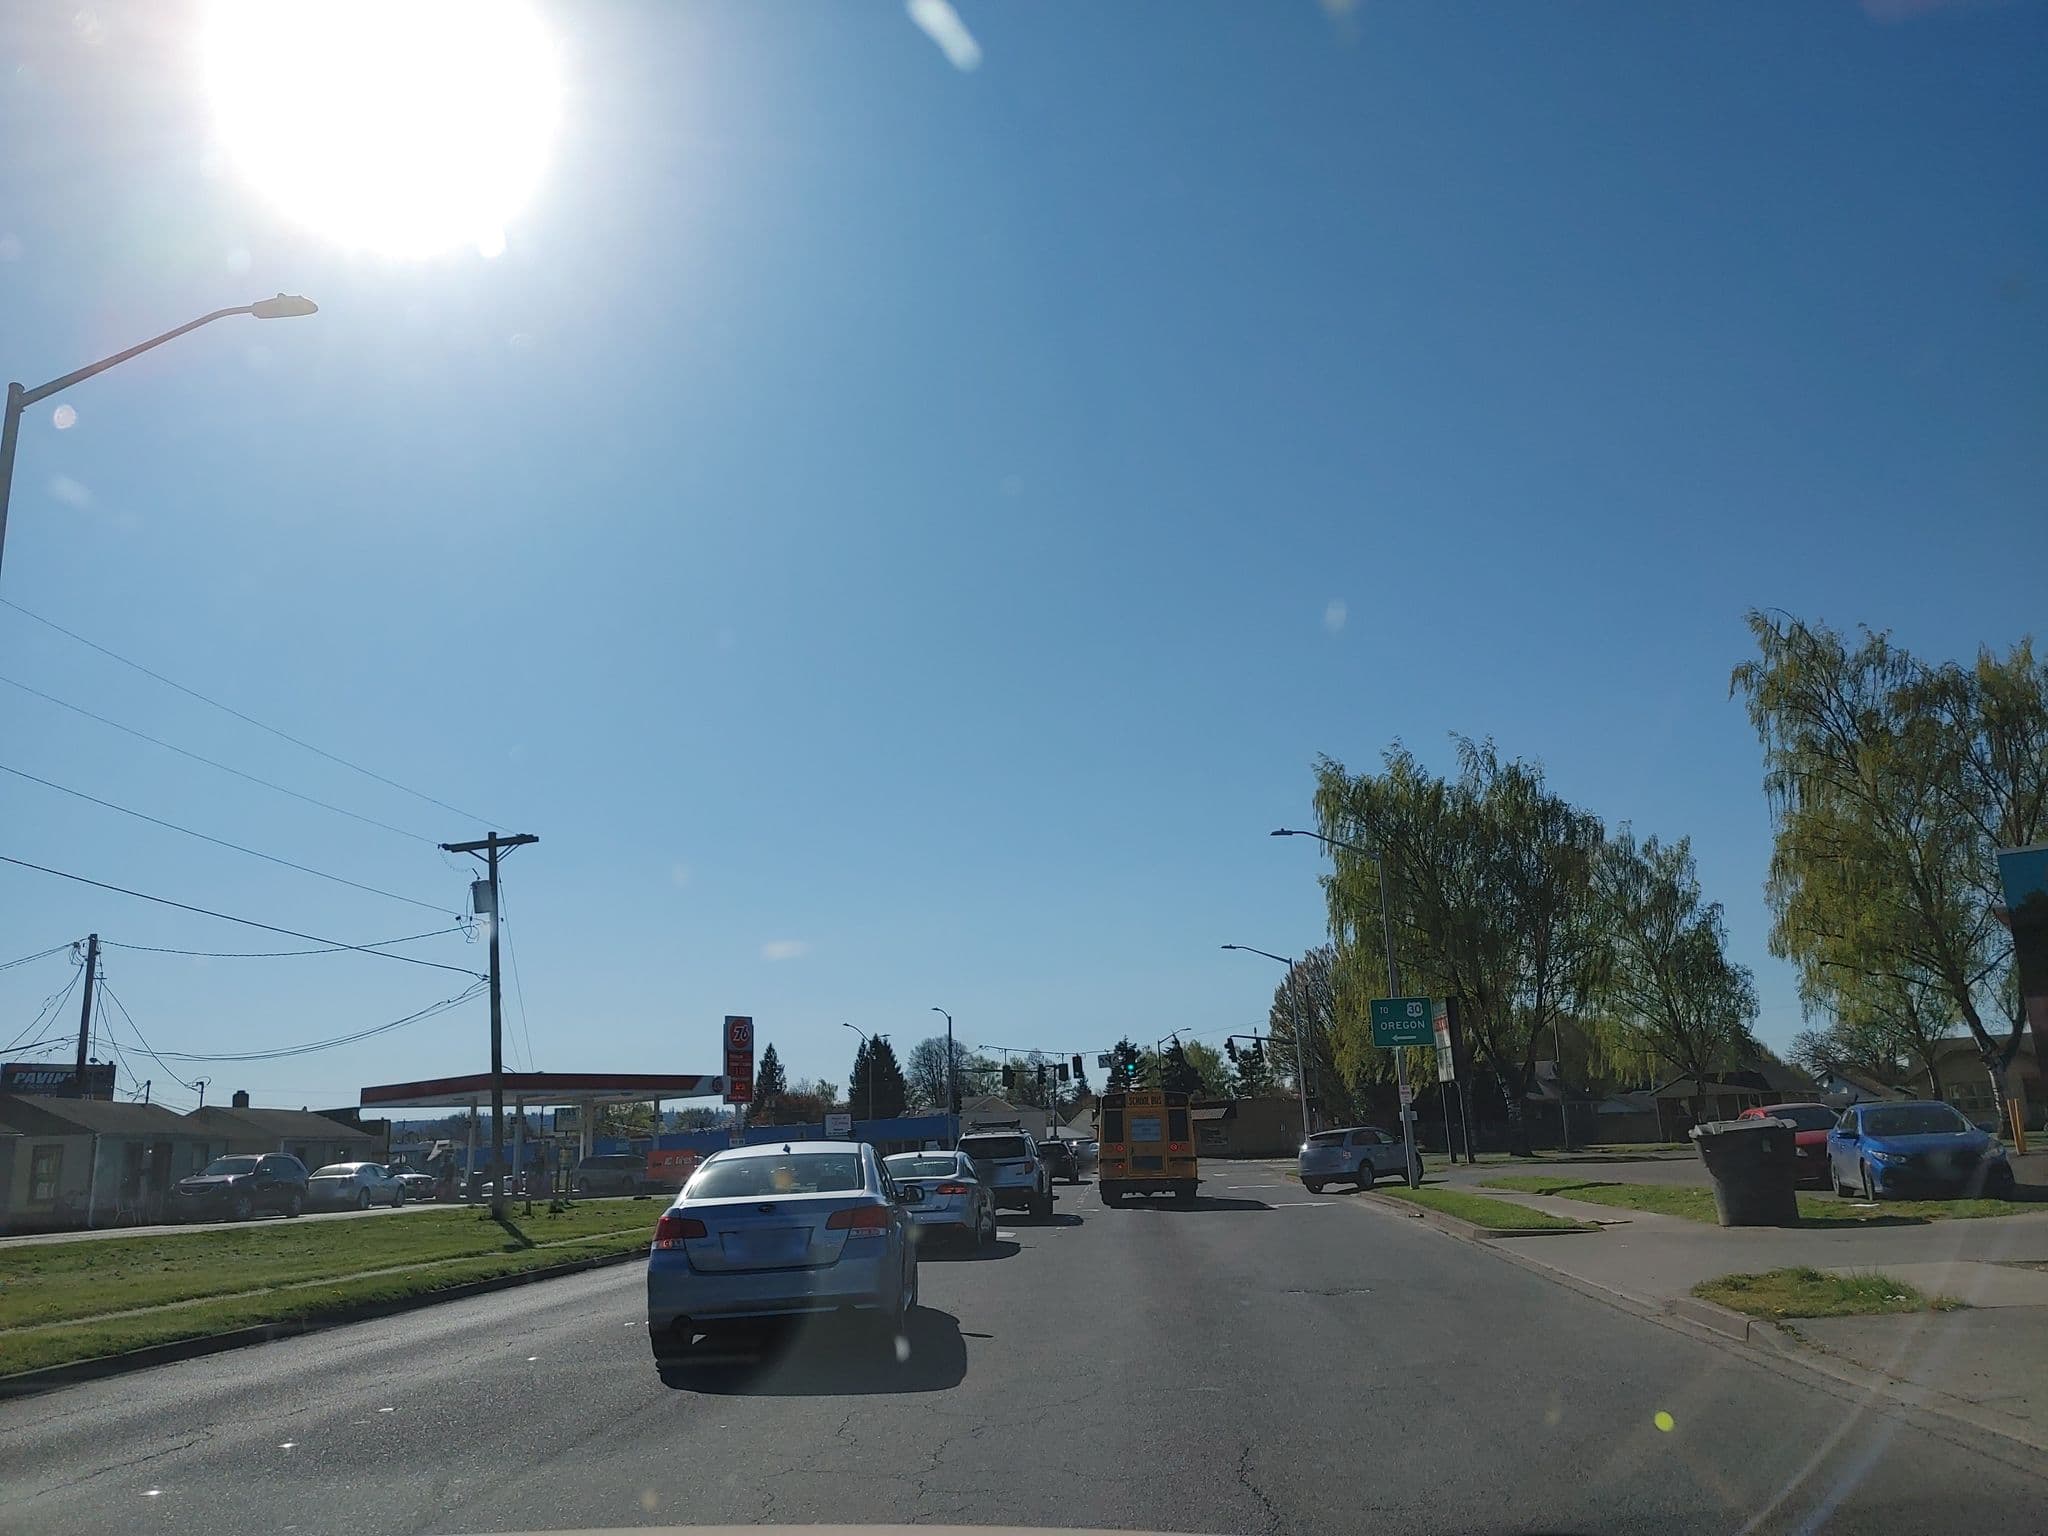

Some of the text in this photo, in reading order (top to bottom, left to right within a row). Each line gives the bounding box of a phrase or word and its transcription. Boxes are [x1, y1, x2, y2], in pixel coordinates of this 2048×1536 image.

[1380, 1004, 1422, 1014] TO 30
[1380, 1020, 1425, 1030] OREGON
[733, 1025, 749, 1041] 76
[1152, 1096, 1162, 1105] BUS
